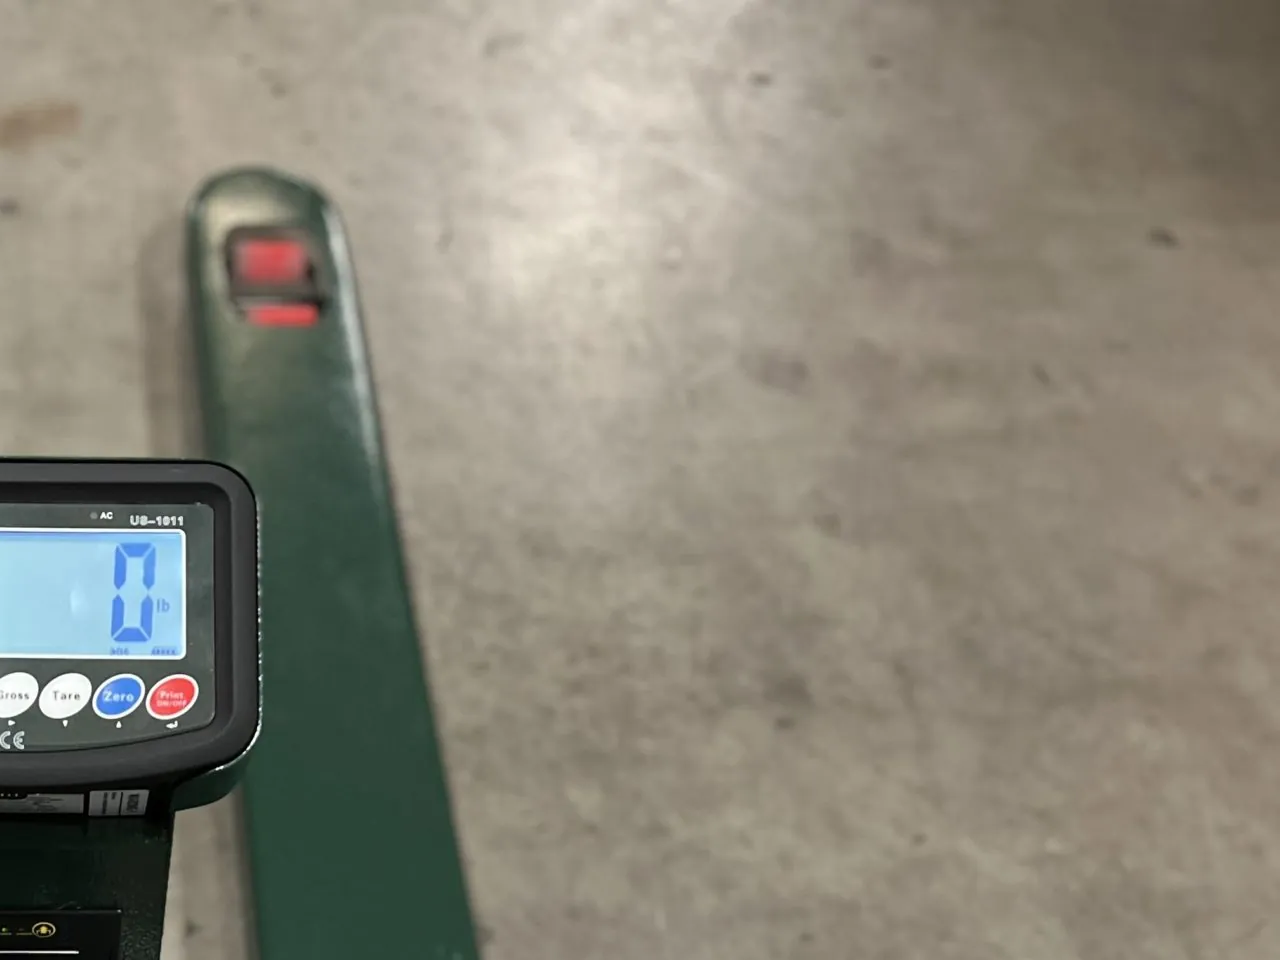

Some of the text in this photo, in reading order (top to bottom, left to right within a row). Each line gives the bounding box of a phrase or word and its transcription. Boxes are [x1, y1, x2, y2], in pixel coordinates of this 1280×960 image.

[100, 511, 113, 520] AC
[111, 542, 156, 643] 0
[157, 598, 170, 613] lb
[53, 690, 81, 701] Tare
[103, 690, 134, 702] Zero
[158, 689, 184, 700] Print
